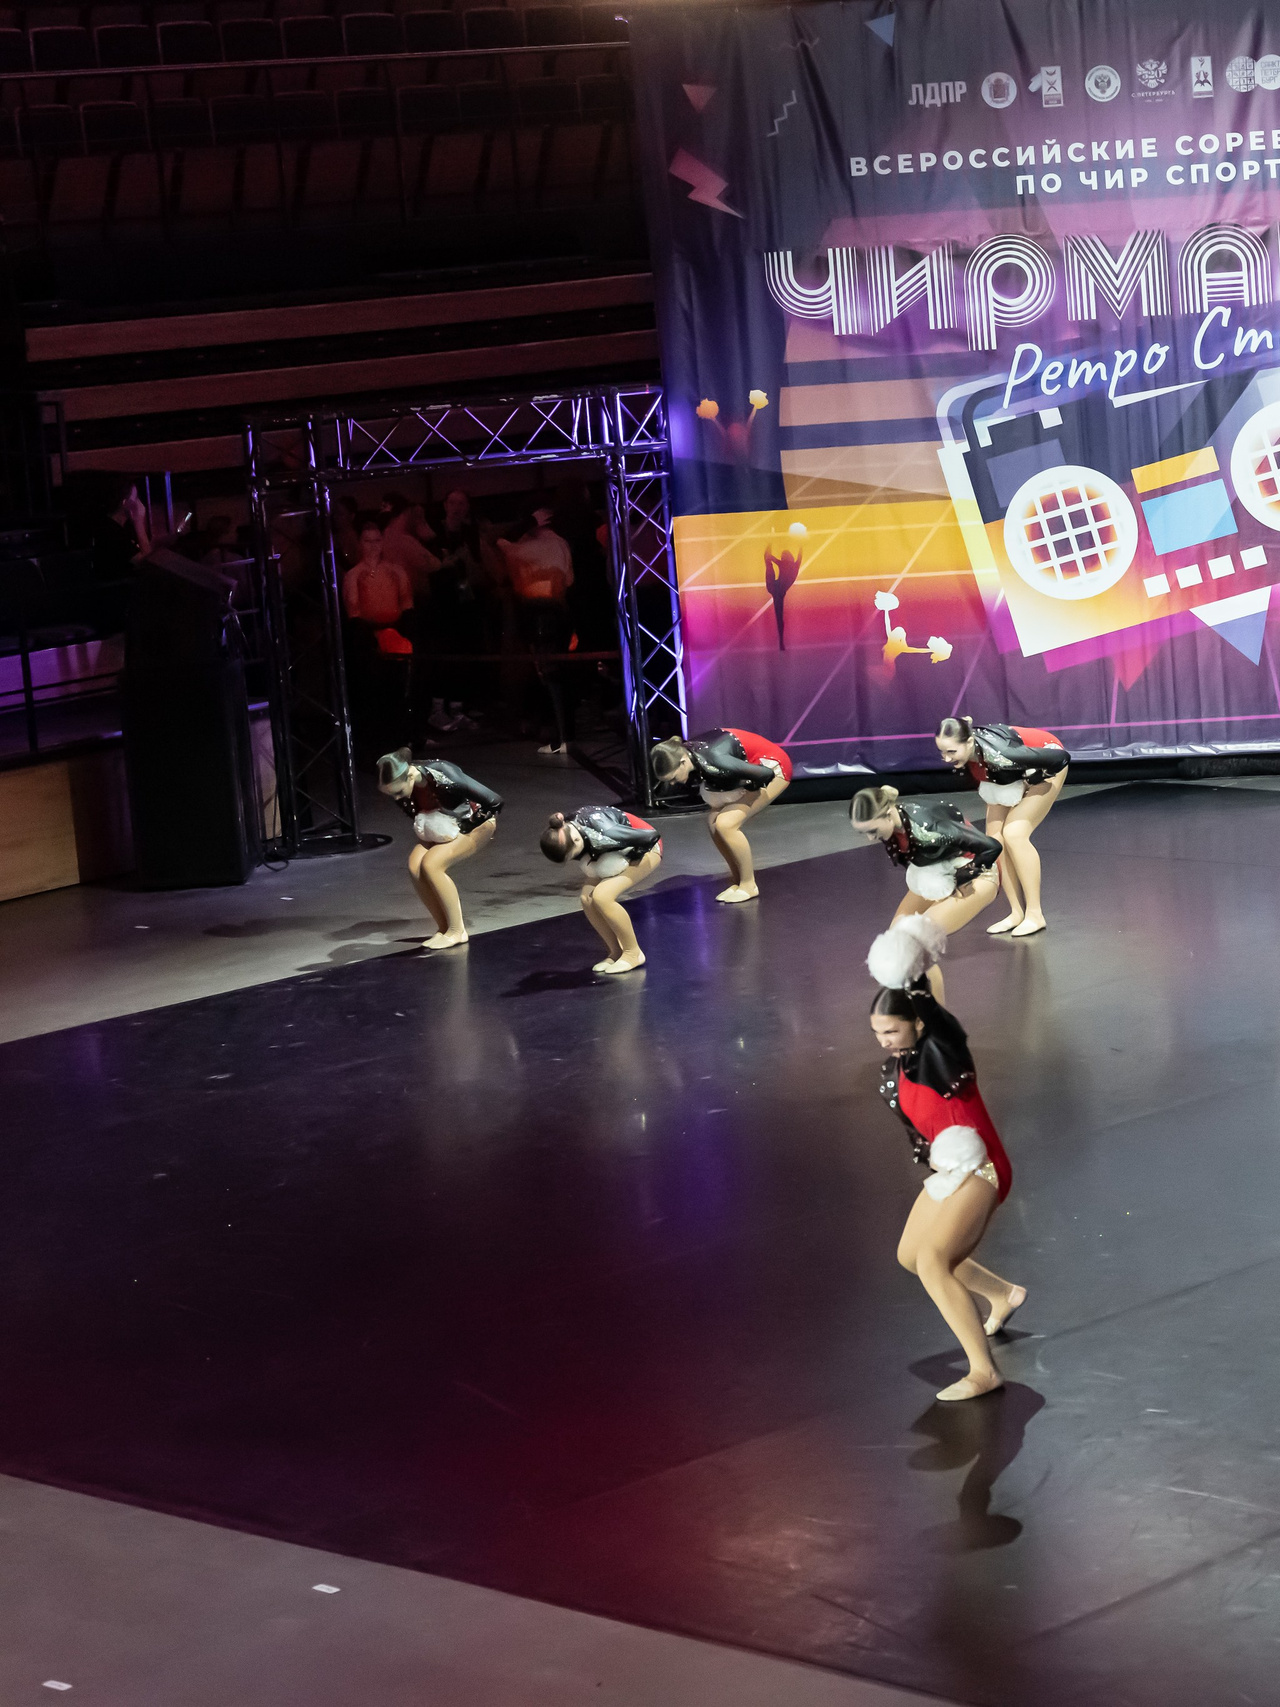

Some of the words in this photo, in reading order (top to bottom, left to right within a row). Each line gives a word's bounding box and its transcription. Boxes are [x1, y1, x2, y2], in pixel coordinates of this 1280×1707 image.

[908, 80, 967, 108] ЛДПР
[850, 137, 1158, 177] ВСЕРОССИЙСКИЕ
[1016, 173, 1063, 195] ПО
[1079, 167, 1149, 191] ЧИР
[1002, 342, 1171, 410] Ретро
